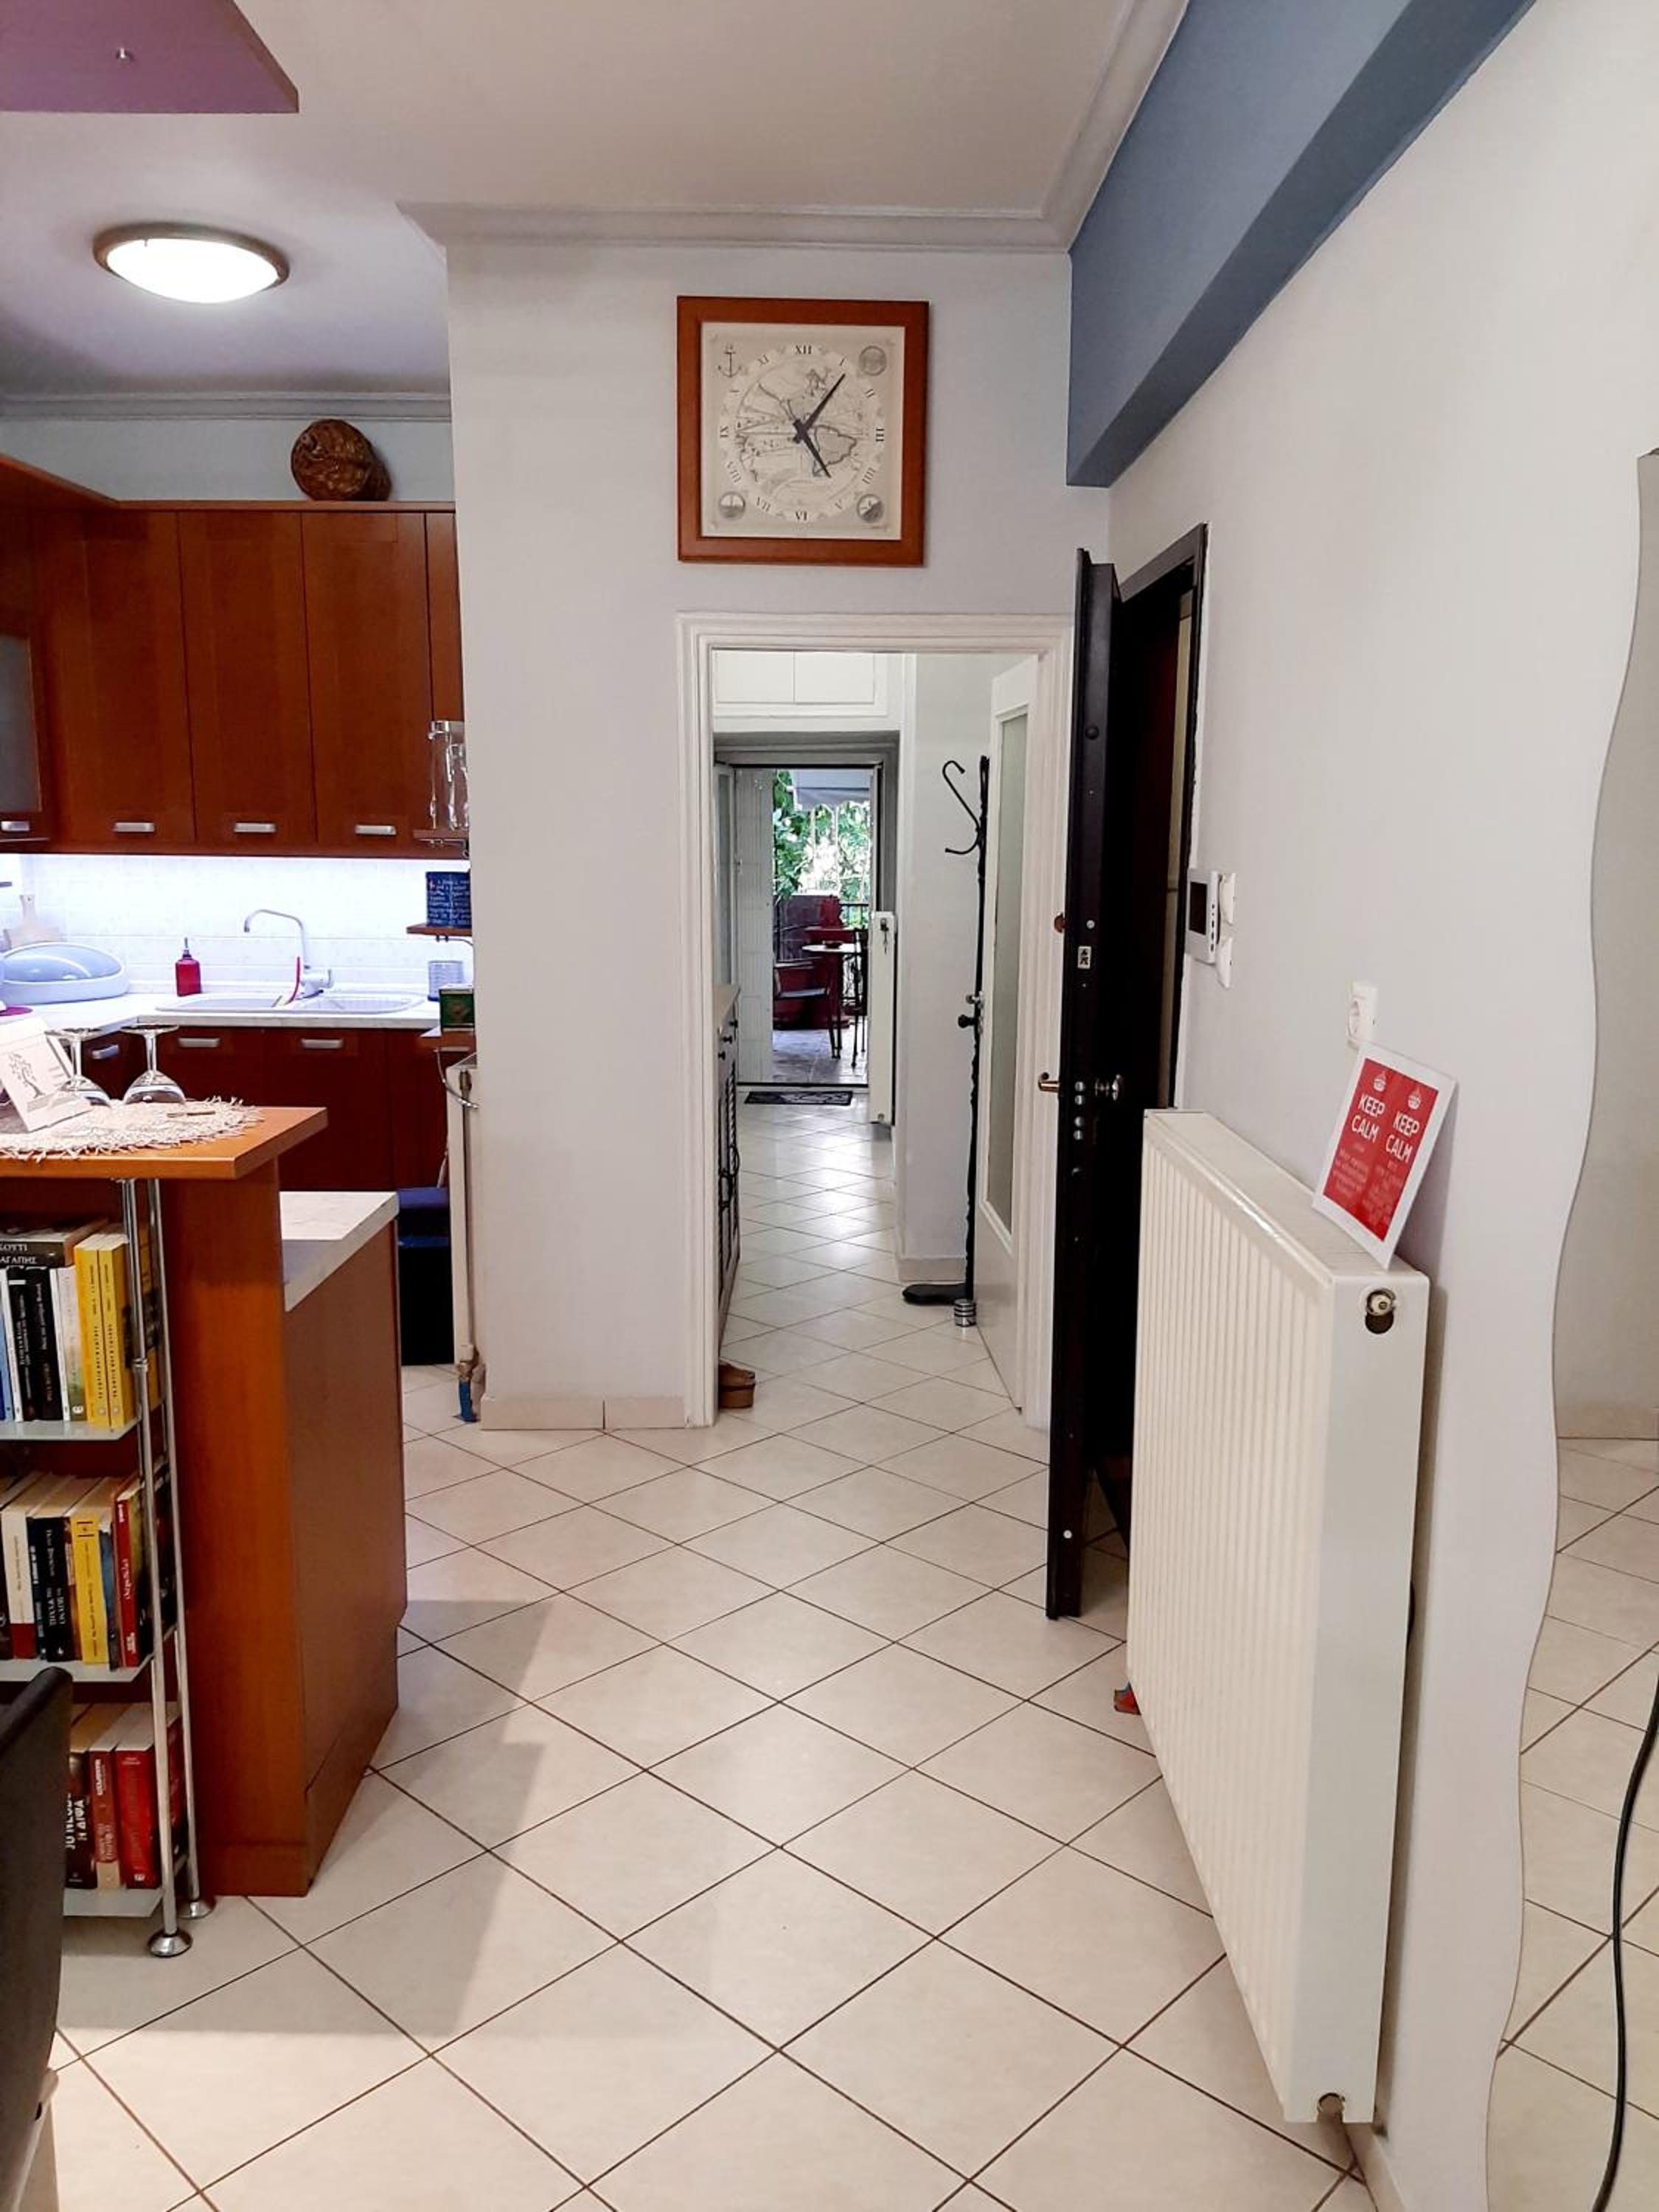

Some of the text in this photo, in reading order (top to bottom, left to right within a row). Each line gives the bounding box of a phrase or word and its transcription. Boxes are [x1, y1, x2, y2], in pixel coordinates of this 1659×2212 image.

[796, 344, 812, 355] XII
[874, 428, 886, 442] III
[795, 510, 809, 521] VI
[1357, 1094, 1385, 1118] KEEP
[1352, 1114, 1380, 1144] CALM
[1393, 1111, 1420, 1138] KEEP
[1385, 1134, 1413, 1164] CALM
